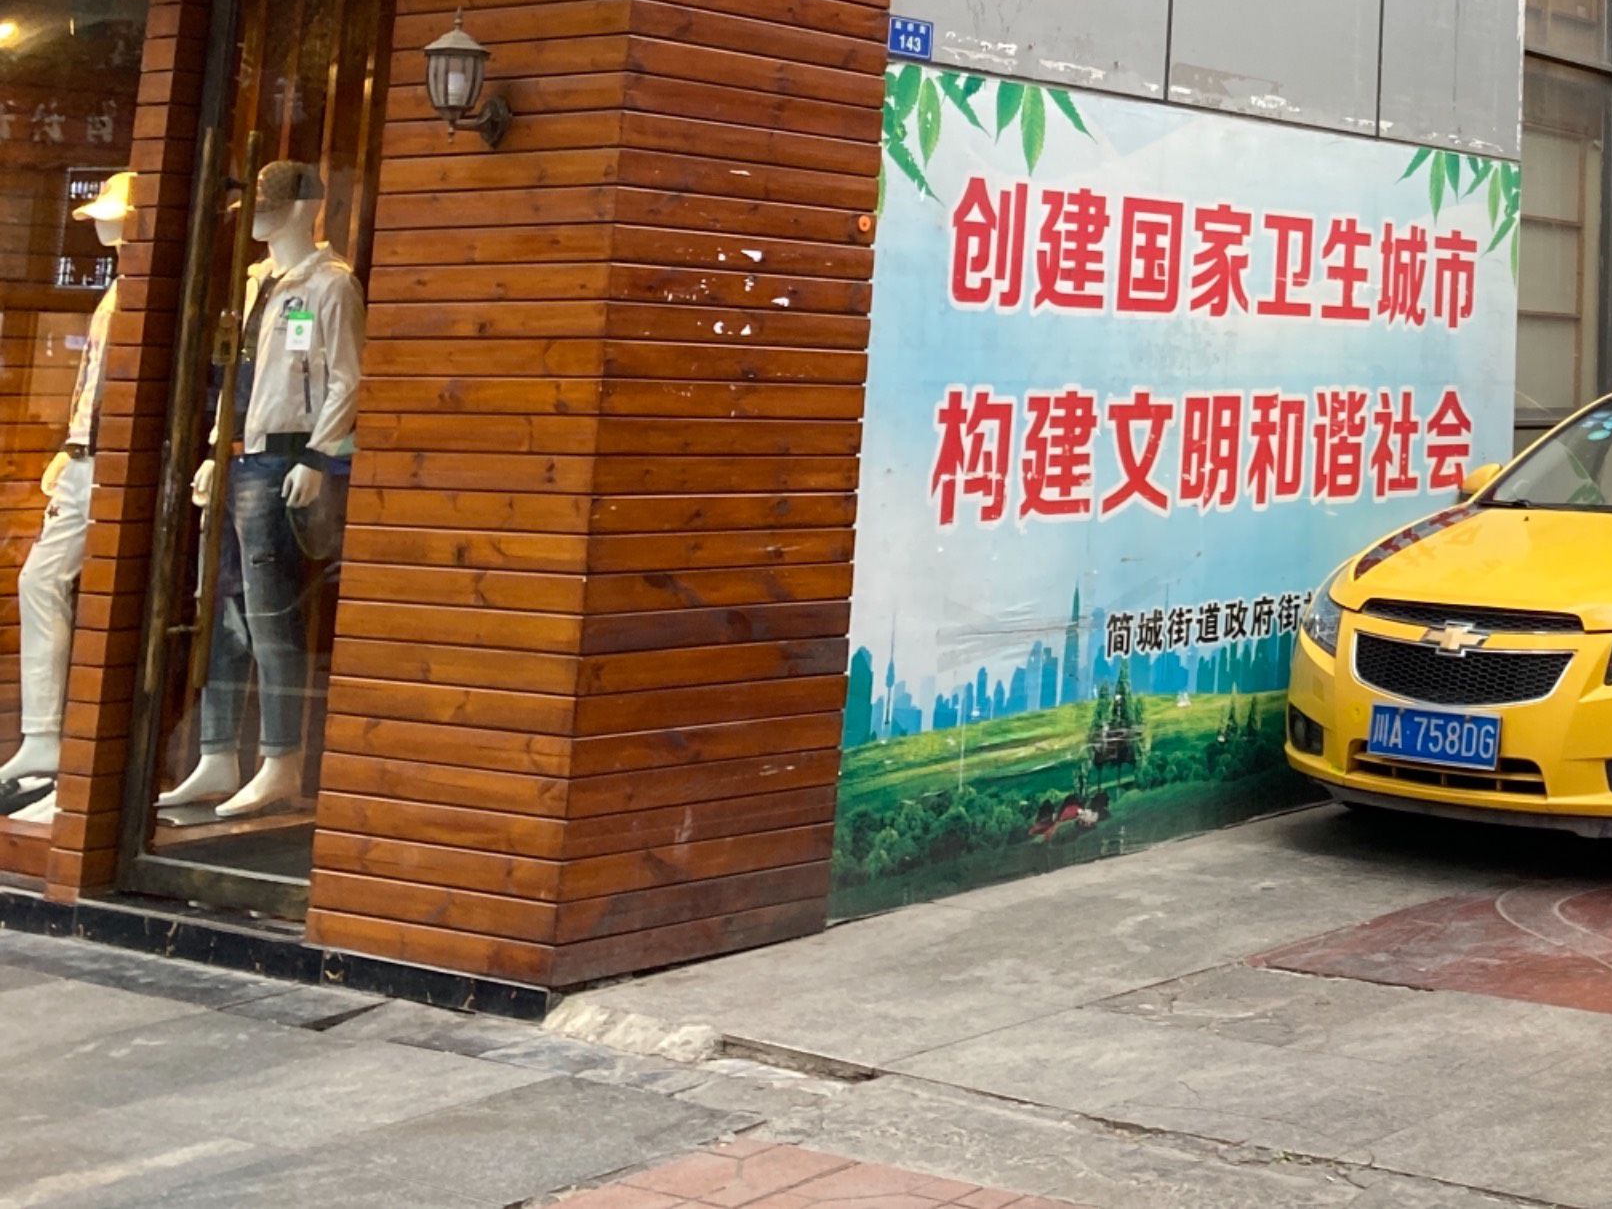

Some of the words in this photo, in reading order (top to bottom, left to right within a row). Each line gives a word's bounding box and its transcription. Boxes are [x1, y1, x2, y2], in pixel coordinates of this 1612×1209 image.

[899, 34, 921, 53] 143
[949, 176, 1479, 329] 创建国家卫生城市
[930, 389, 1473, 527] 构建文明和谐社会
[1106, 591, 1312, 658] 简城街道政府街
